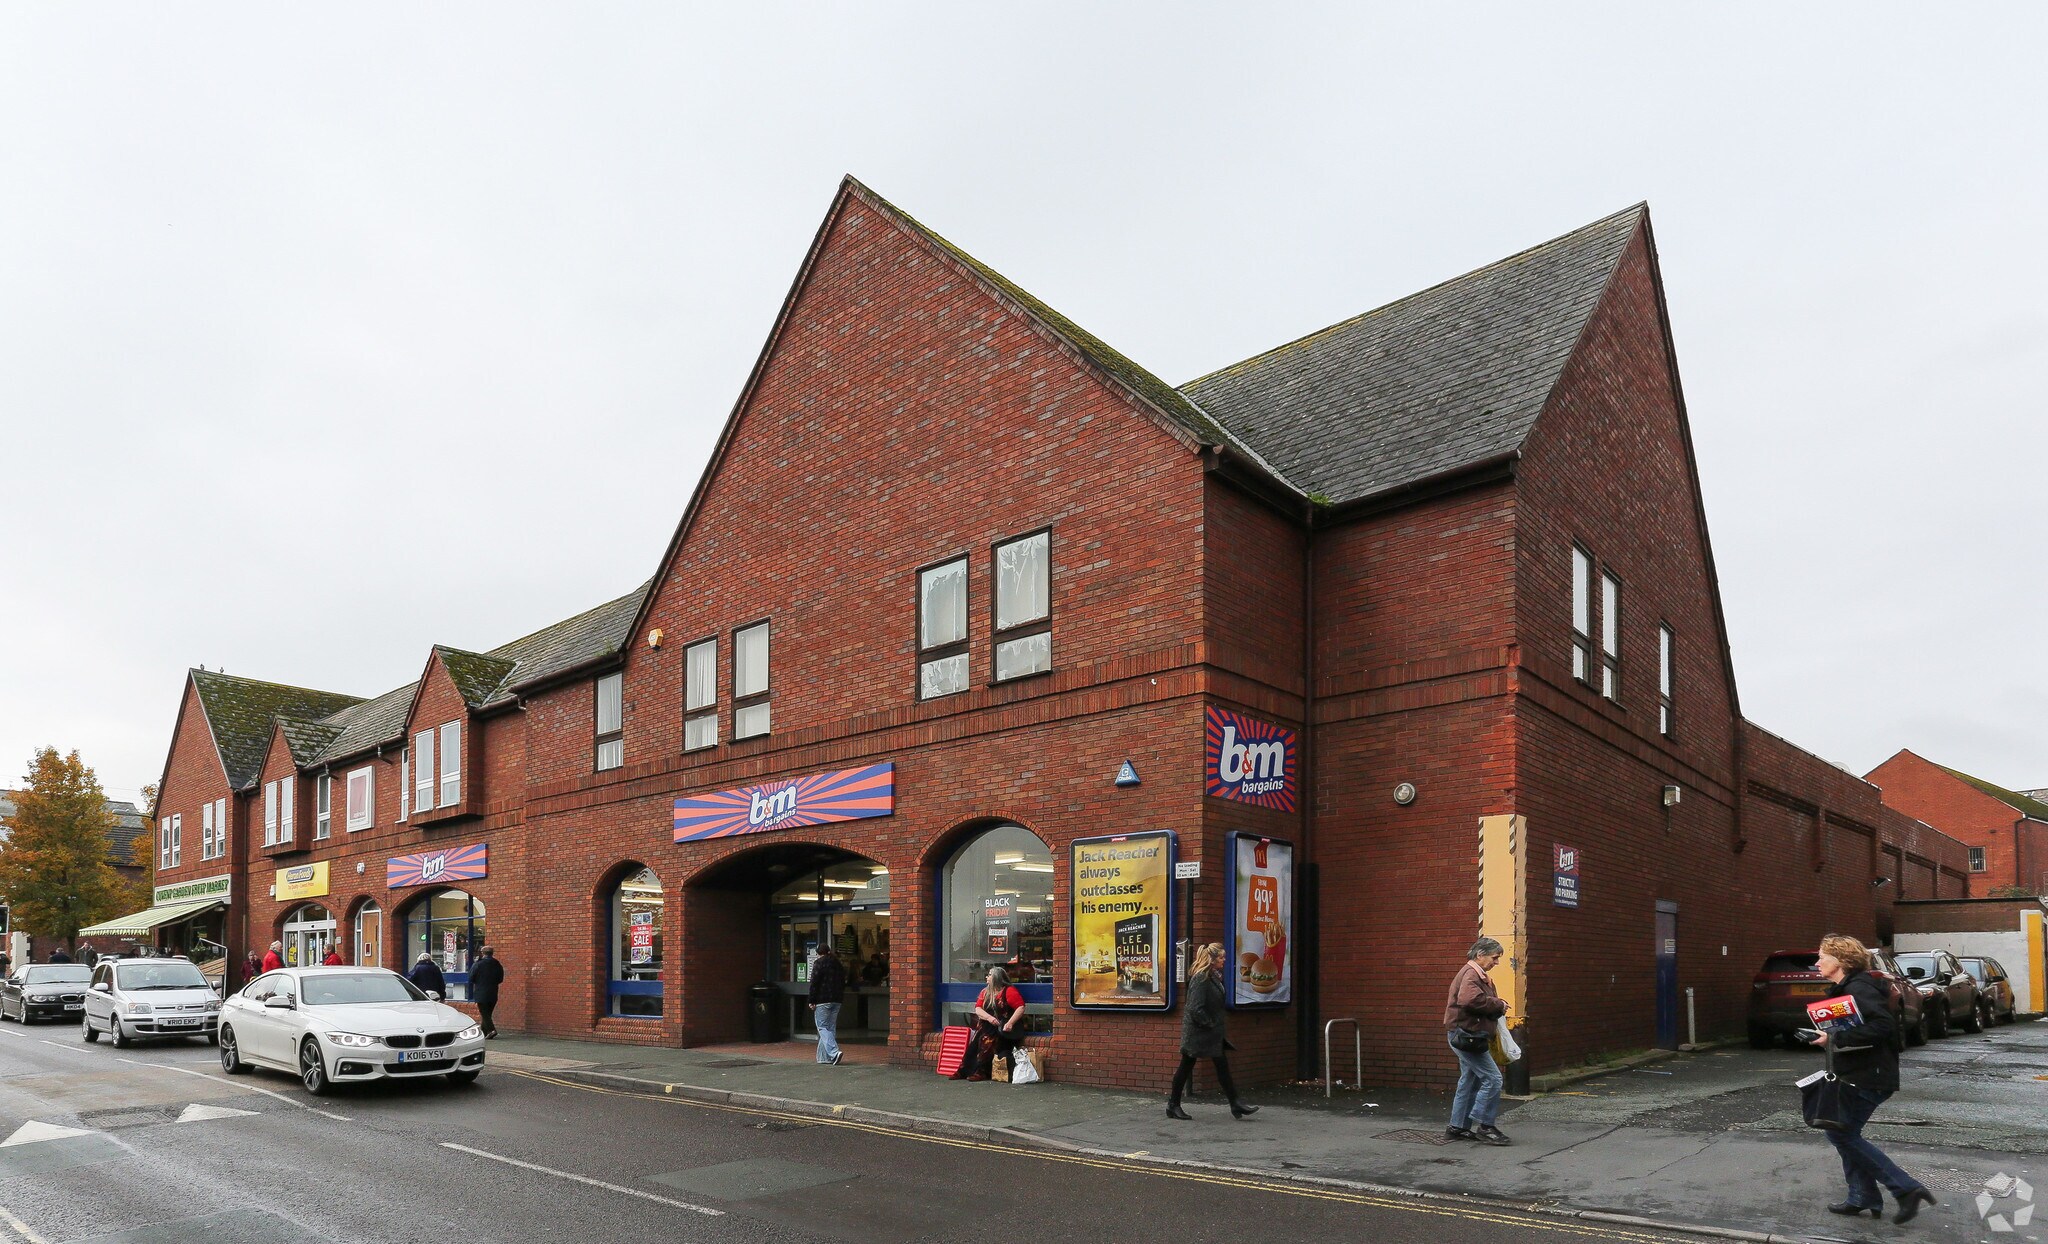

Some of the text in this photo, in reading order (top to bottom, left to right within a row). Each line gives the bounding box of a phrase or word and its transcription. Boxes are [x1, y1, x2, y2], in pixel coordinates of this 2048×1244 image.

[1221, 726, 1284, 782] b&m
[1241, 778, 1284, 794] bargains
[750, 785, 797, 825] b&m
[764, 809, 797, 828] bargains
[1079, 846, 1160, 864] Jack Reacher
[422, 854, 446, 879] b&m
[1080, 866, 1121, 880] always
[1081, 882, 1144, 898] outclasses
[1555, 886, 1578, 900] NO PARKING
[985, 898, 1010, 908] BLACK
[1081, 900, 1097, 914] his
[985, 907, 1010, 917] FRIDAY
[633, 935, 650, 946] SALE
[1122, 934, 1142, 945] LEE
[1116, 944, 1151, 955] CHILD
[1817, 1008, 1833, 1019] 6
[429, 1050, 444, 1058] YSV
